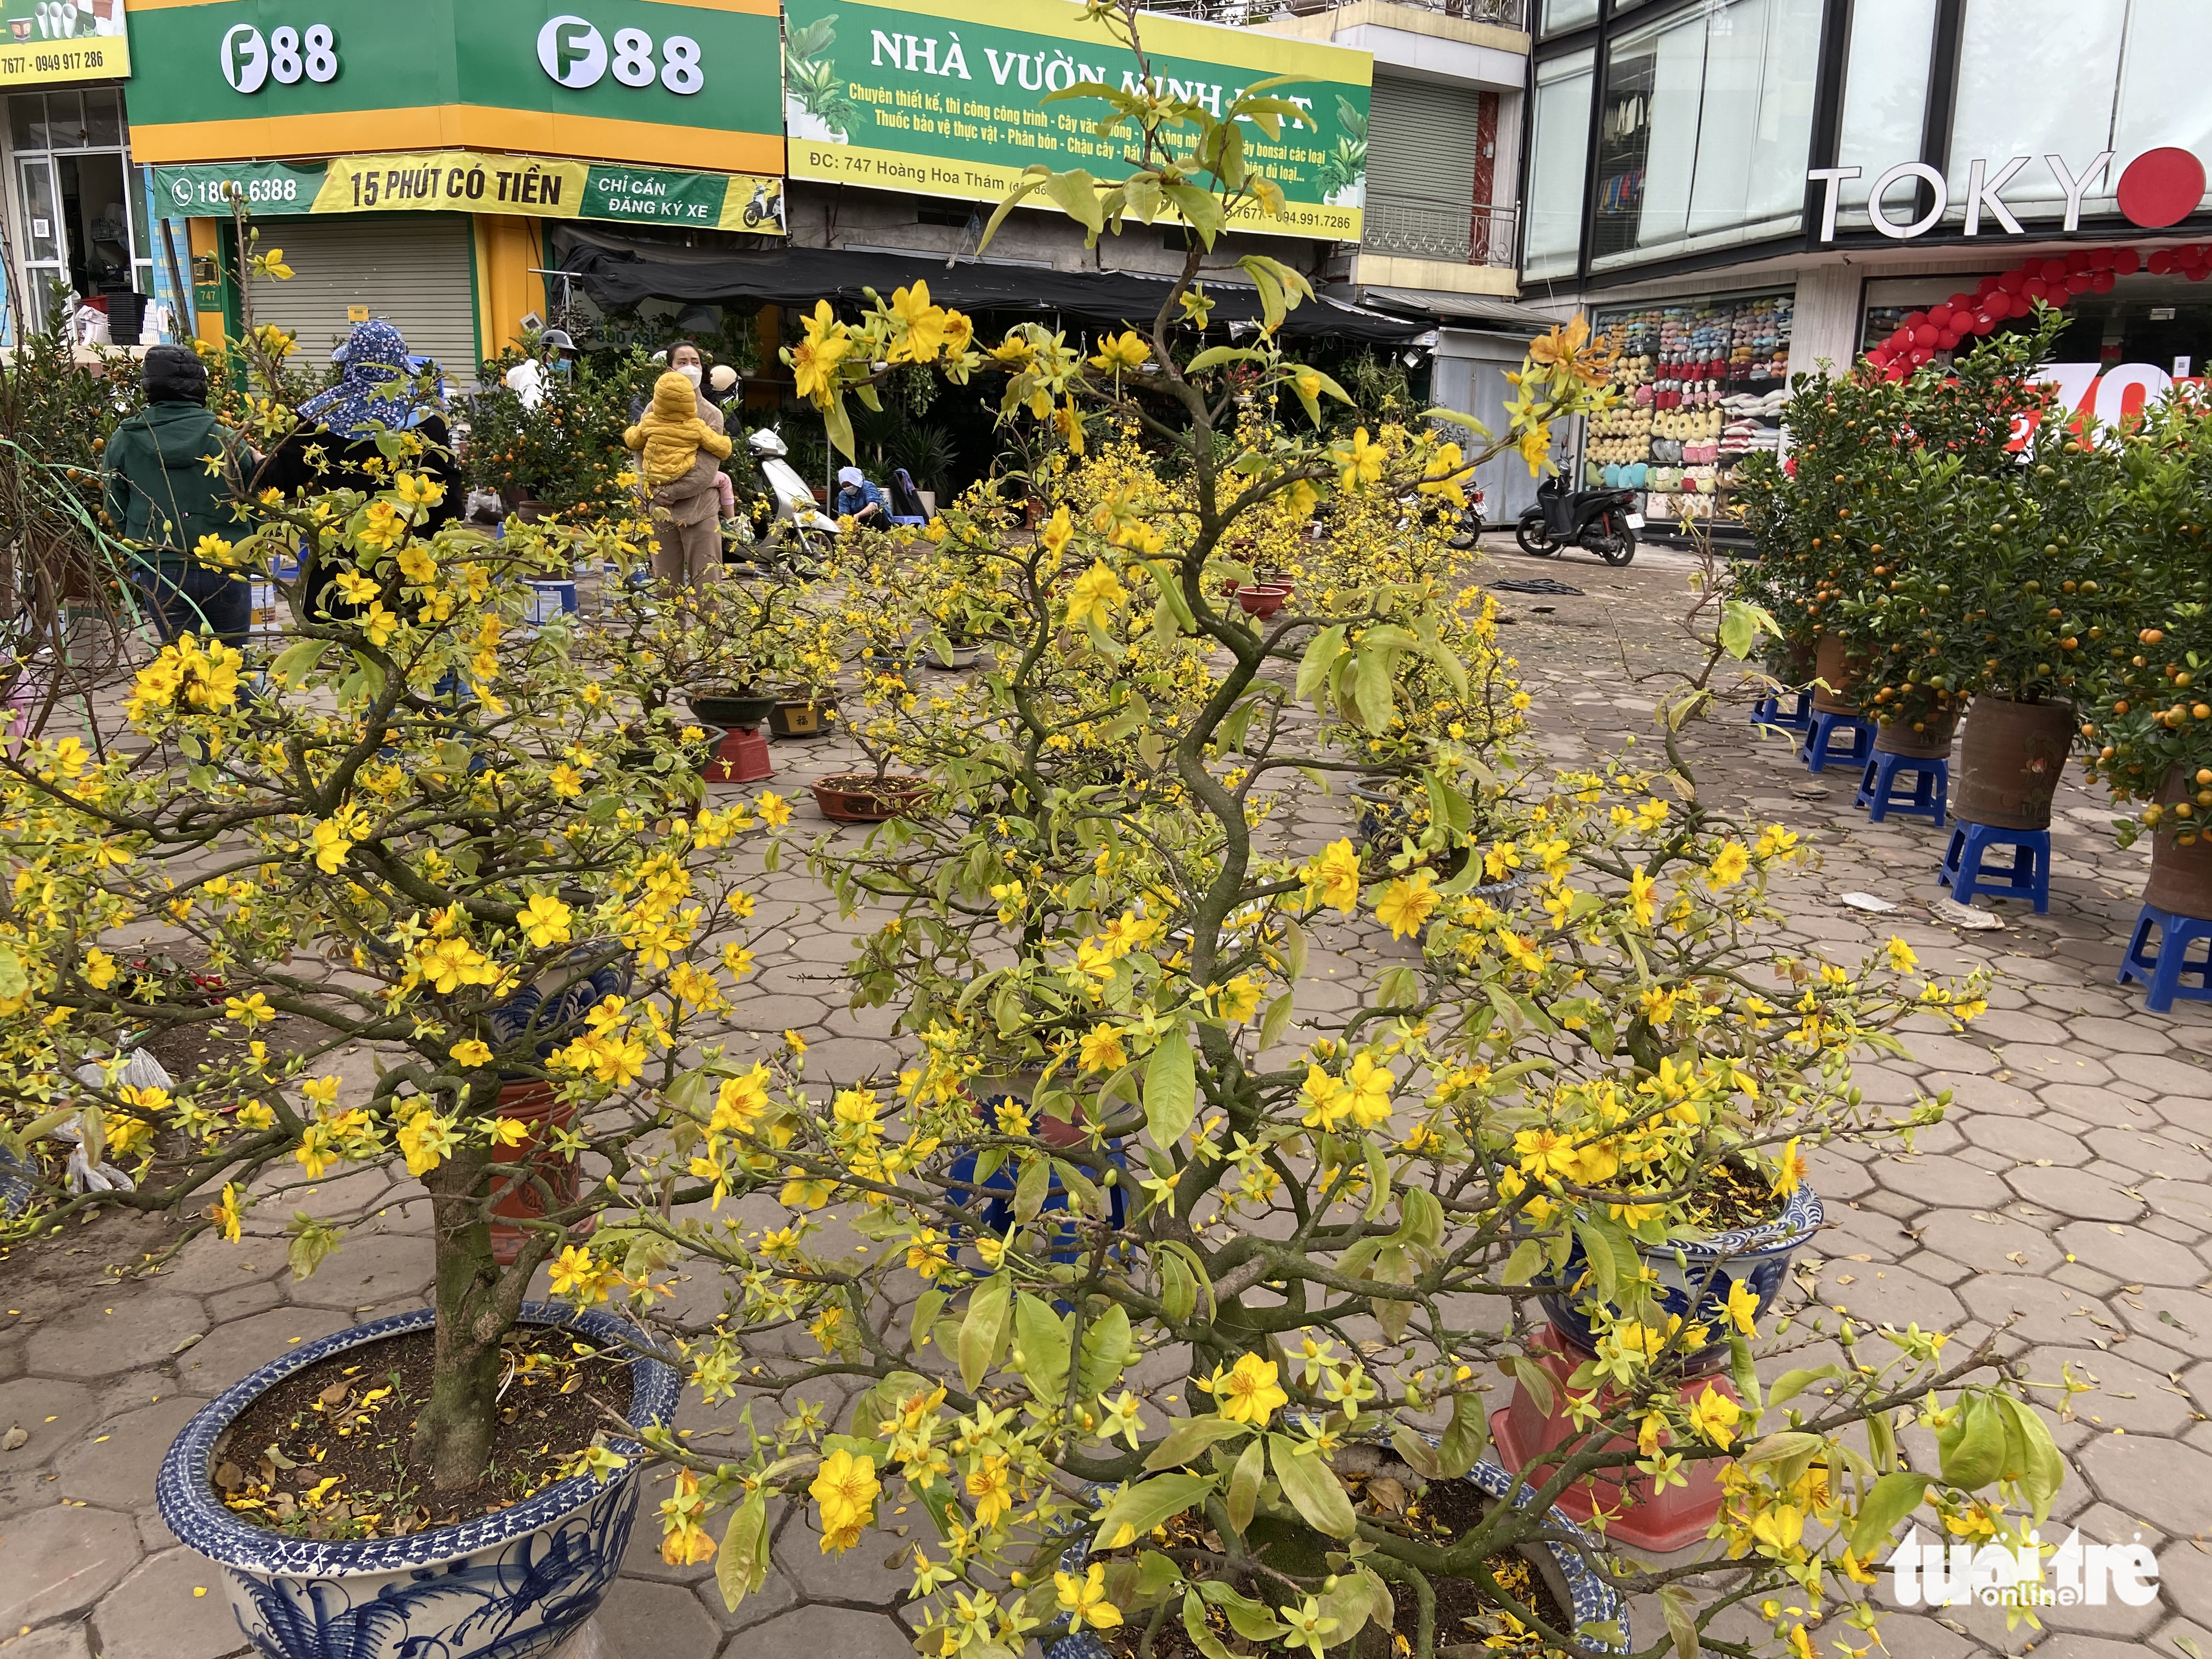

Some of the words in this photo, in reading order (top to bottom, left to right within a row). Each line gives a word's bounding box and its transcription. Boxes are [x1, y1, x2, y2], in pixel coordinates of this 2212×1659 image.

[2, 57, 25, 74] 7677
[35, 54, 60, 71] 0949
[63, 53, 81, 69] 917
[84, 51, 103, 68] 286
[221, 24, 338, 93] F88
[537, 15, 704, 94] F88
[871, 30, 972, 80] NHÀ
[849, 83, 893, 105] Chuyên
[896, 89, 922, 109] thiết
[926, 92, 943, 114] kế,
[945, 97, 961, 114] thi
[963, 100, 991, 121] công
[994, 105, 1020, 126] công
[1023, 109, 1048, 127] trình
[1058, 114, 1078, 133] Cây
[1159, 129, 1183, 148] công
[1256, 142, 1288, 160] bonsai
[1289, 146, 1306, 162] các
[1308, 149, 1326, 167] loại
[875, 109, 910, 130] Thuốc
[913, 114, 934, 133] bảo
[937, 119, 951, 139] vệ
[953, 120, 978, 142] thực
[980, 125, 998, 145] vật
[1008, 128, 1035, 148] Phân
[1037, 133, 1057, 150] bón
[1067, 137, 1093, 158] Chậu
[1096, 142, 1114, 160] cây
[1266, 163, 1278, 179] đủ
[249, 178, 296, 201] 6388
[351, 171, 380, 207] 15
[385, 163, 442, 200] PHÚT
[446, 163, 486, 199] CÓ
[496, 165, 561, 205] TIỀN
[599, 175, 629, 193] CHỈ
[631, 177, 666, 196] CẦN
[810, 152, 839, 169] ĐC:
[844, 157, 871, 173] 747
[877, 161, 926, 183] Hoàng
[932, 168, 960, 184] Hoa
[964, 172, 1005, 190] Thám
[609, 196, 655, 215] ĐĂNG
[661, 200, 684, 216] KÝ
[686, 204, 709, 218] XE
[200, 291, 216, 301] 747
[796, 715, 808, 726] 福
